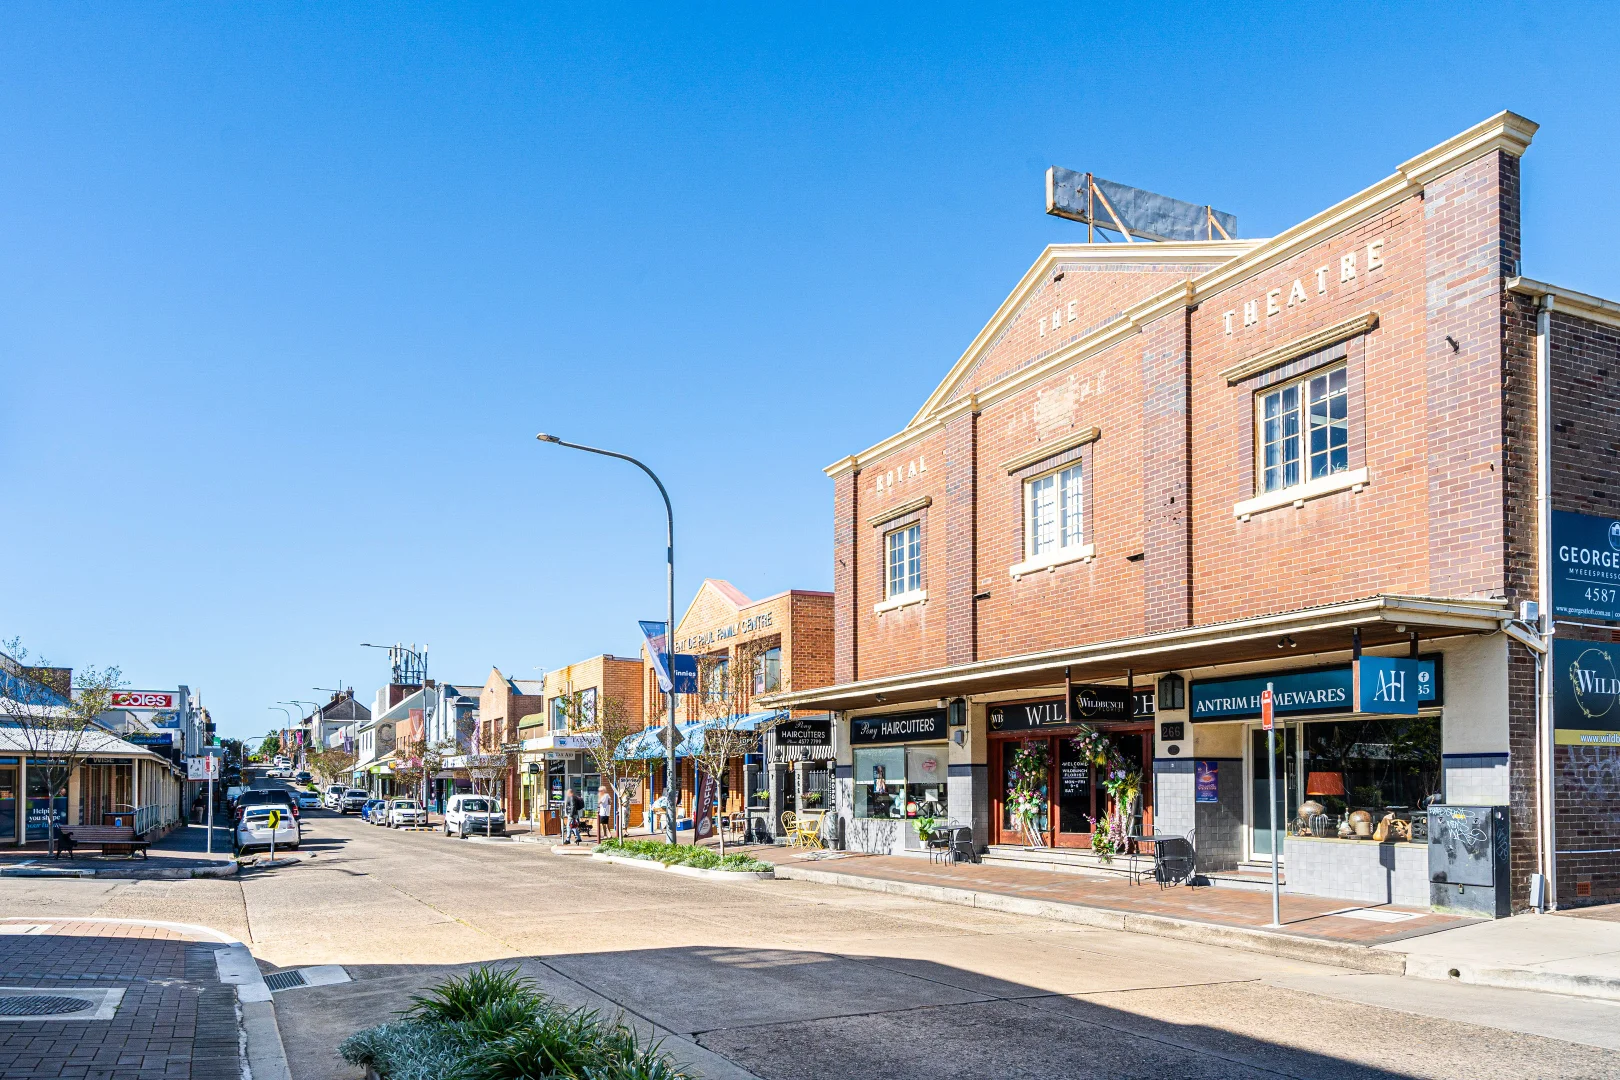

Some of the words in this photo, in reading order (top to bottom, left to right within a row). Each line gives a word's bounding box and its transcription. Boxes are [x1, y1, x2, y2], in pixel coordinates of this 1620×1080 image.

[1223, 238, 1384, 336] THEATRE
[1039, 300, 1077, 338] THE
[876, 455, 928, 493] ROYAL
[1559, 545, 1620, 569] GEORGE
[1584, 587, 1616, 603] 4587
[698, 631, 715, 646] PAUL
[717, 622, 740, 642] FAMILY
[741, 612, 773, 634] CENTRE
[672, 668, 697, 677] innies
[1373, 669, 1406, 703] AH
[1080, 697, 1124, 709] WILDBUNCH
[1196, 696, 1249, 713] ANTRIM
[1250, 687, 1346, 709] HMEWARES
[781, 730, 826, 739] HAIRCUTTERS
[795, 721, 812, 731] Pony
[860, 721, 878, 739] Pony
[881, 717, 935, 735] HAIRCUTTERS
[1162, 726, 1181, 738] 266
[32, 807, 58, 815] Helpig
